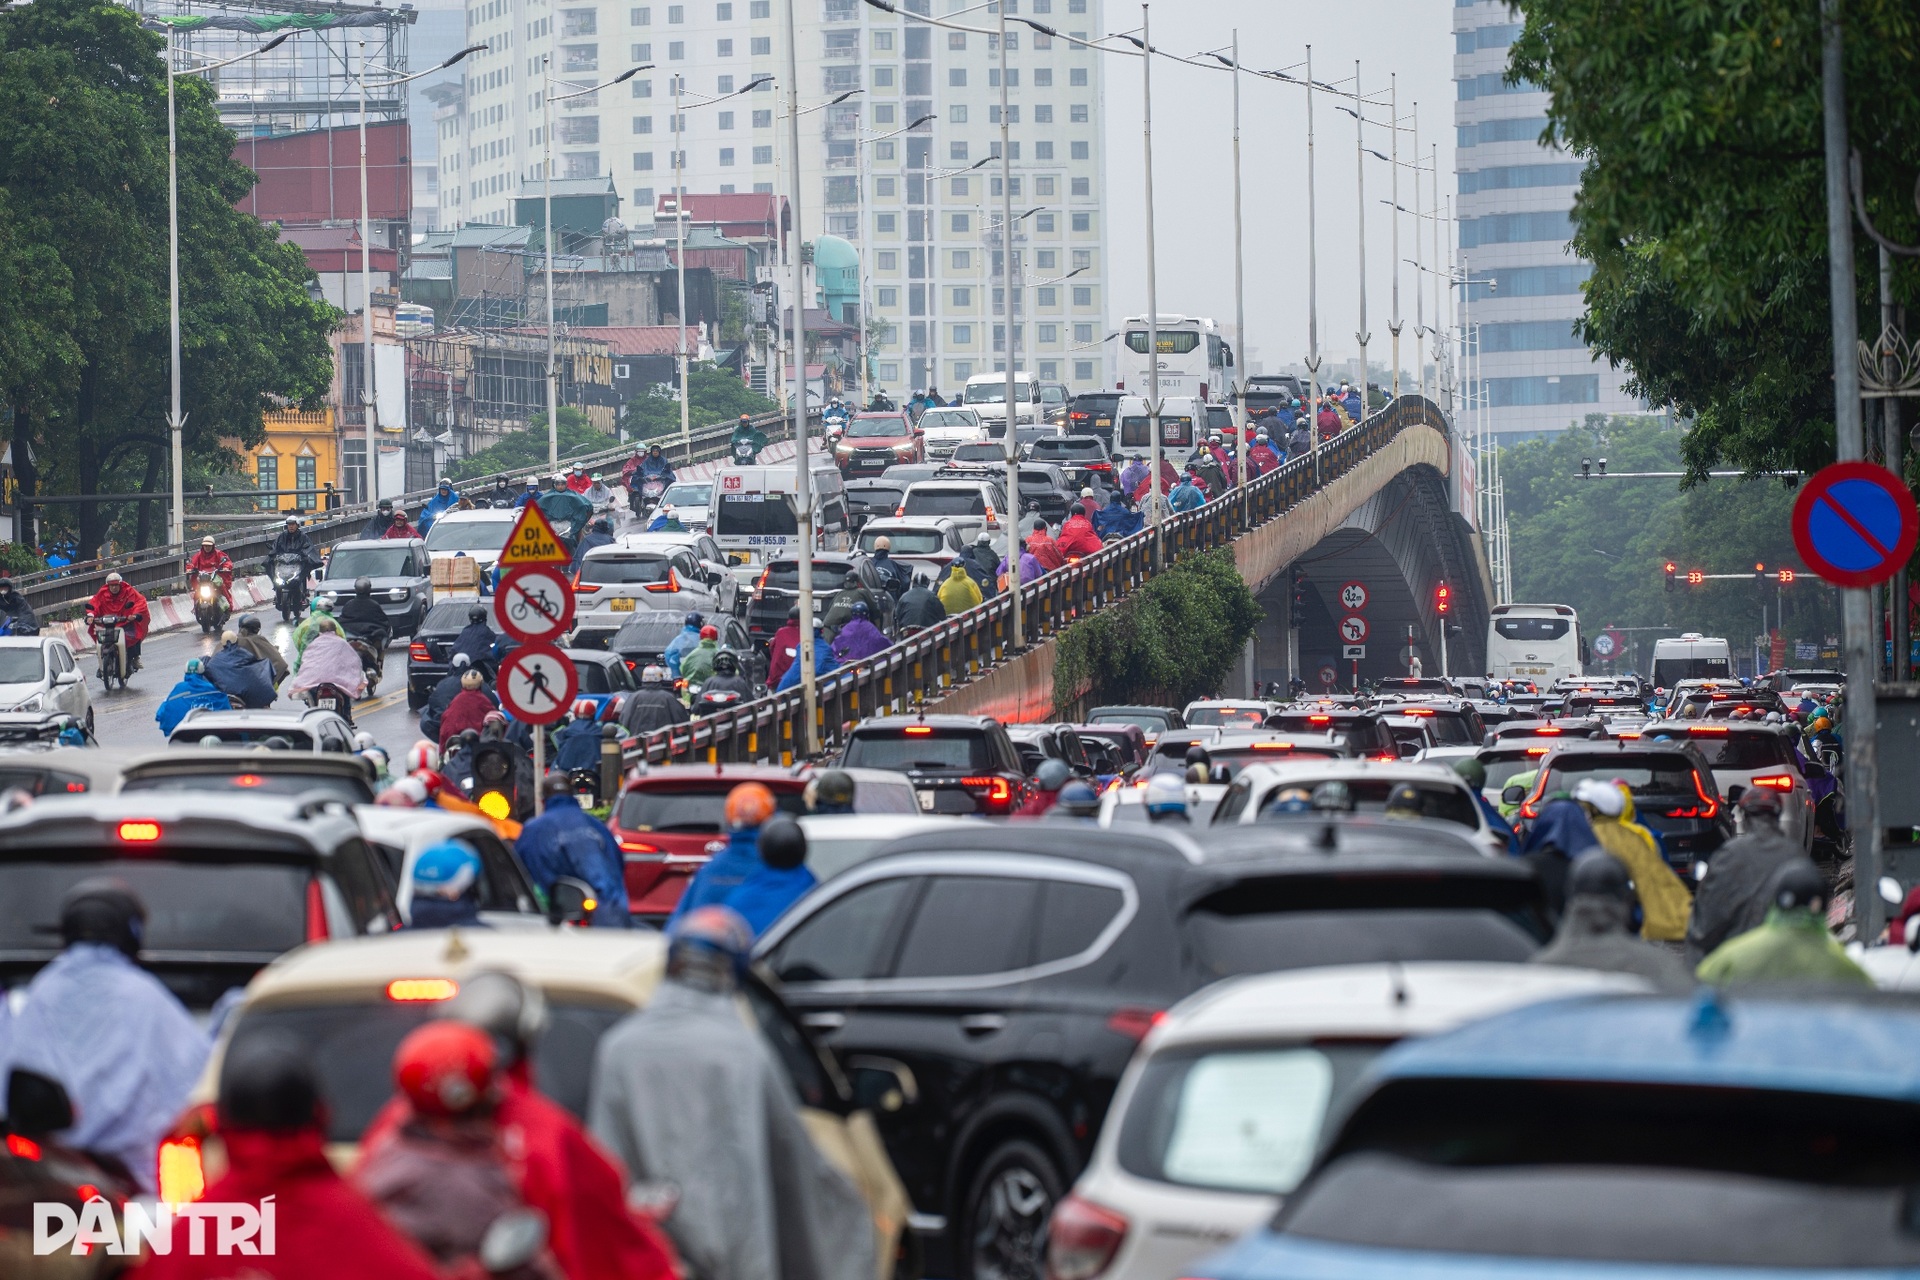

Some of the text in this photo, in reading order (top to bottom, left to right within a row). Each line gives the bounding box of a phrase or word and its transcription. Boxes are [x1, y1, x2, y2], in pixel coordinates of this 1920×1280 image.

[524, 527, 540, 541] ĐI
[748, 536, 787, 545] 29H-955.09
[510, 541, 555, 560] CHẬM
[1688, 572, 1702, 583] 33
[1780, 570, 1793, 581] 33
